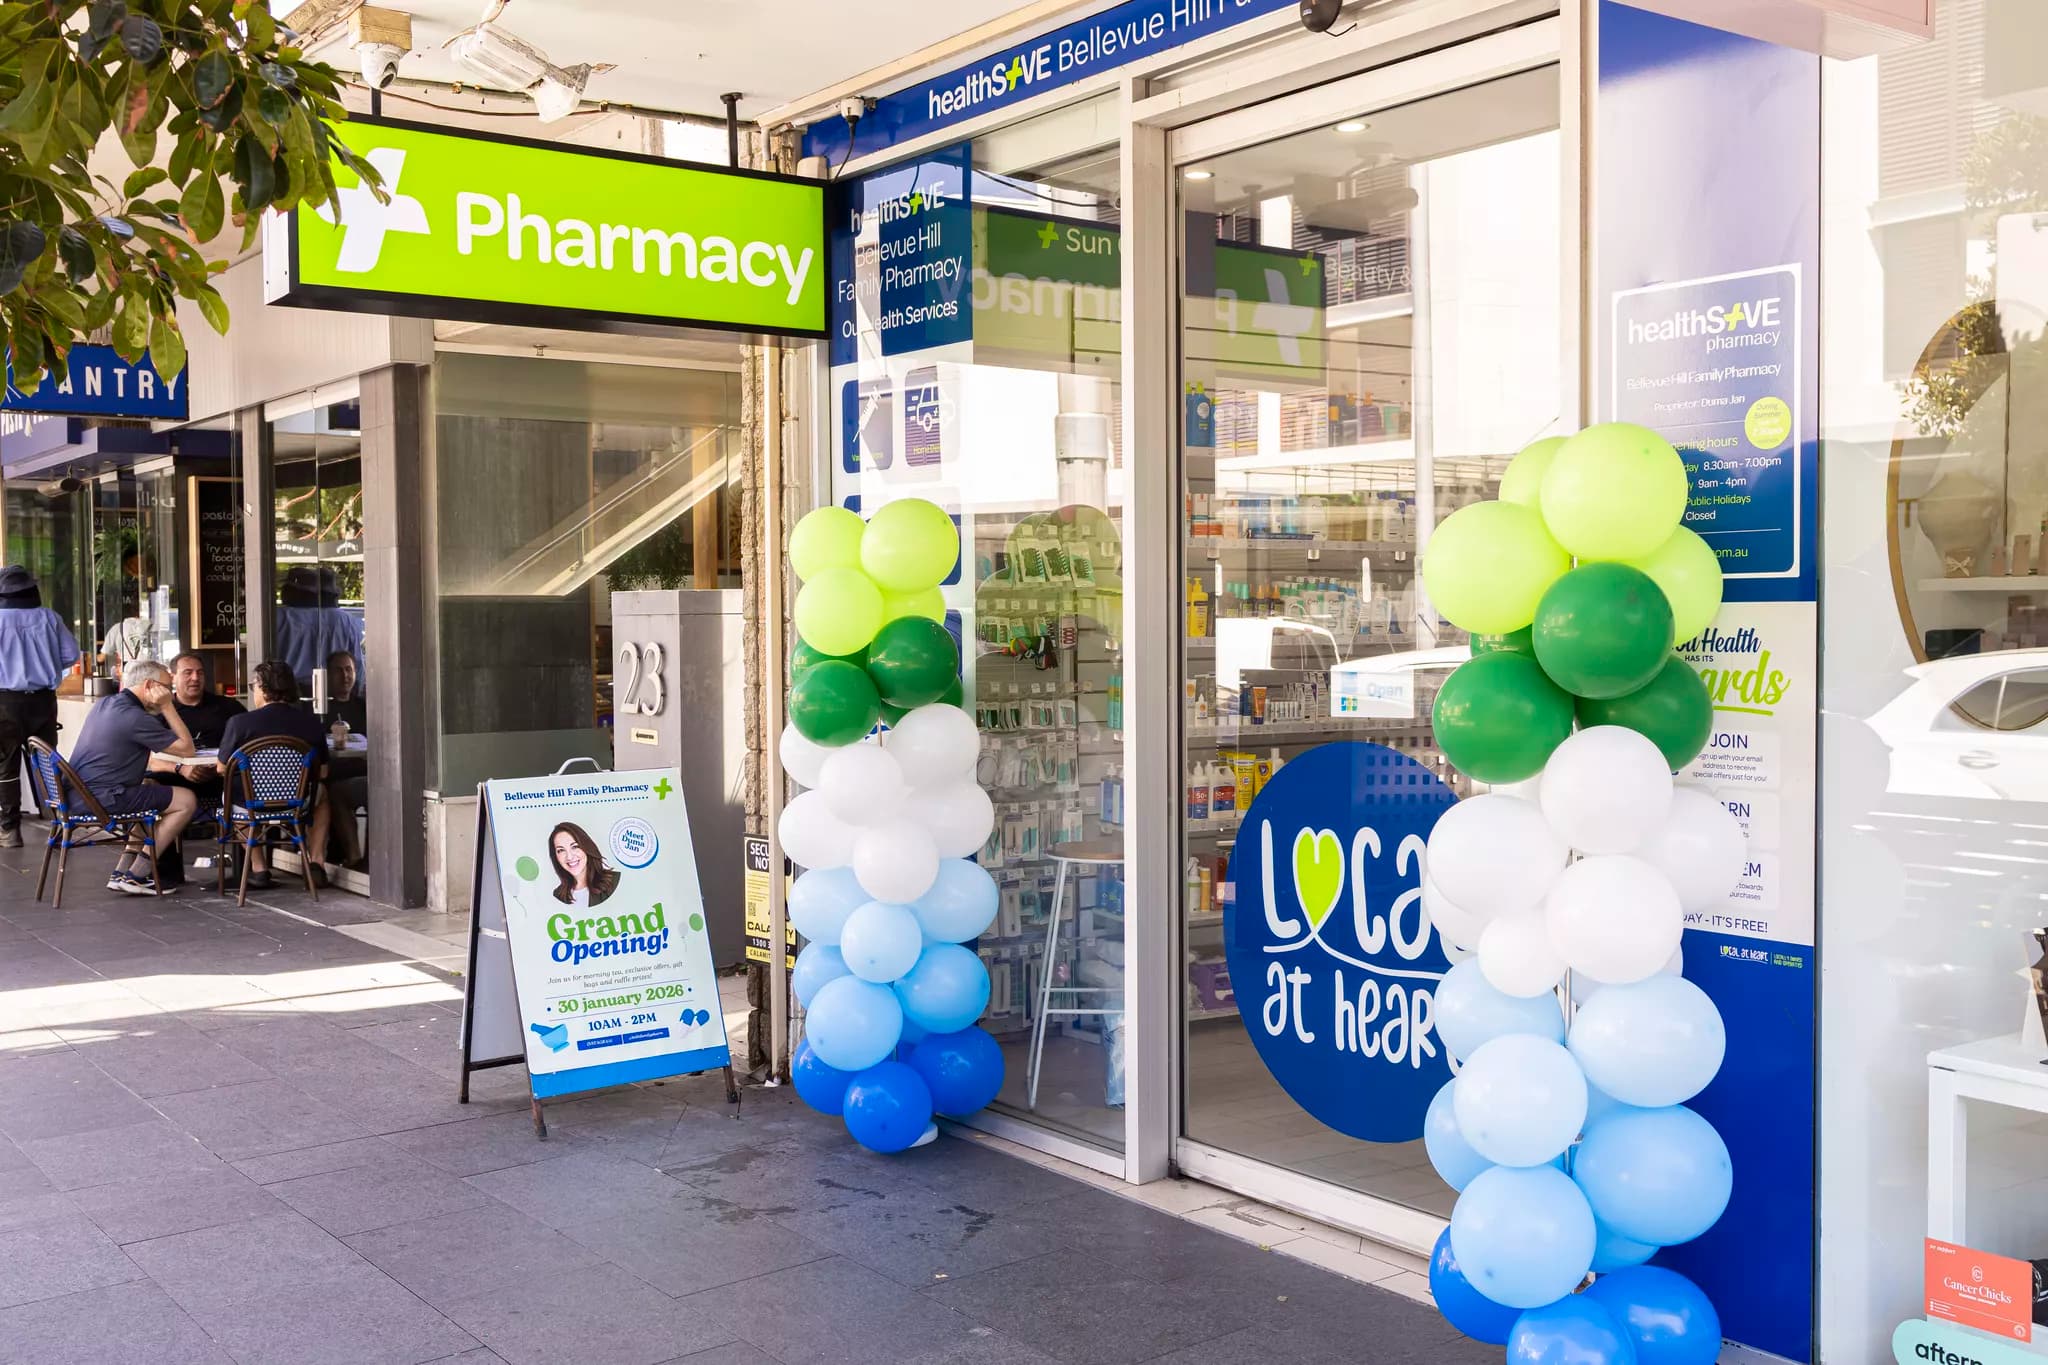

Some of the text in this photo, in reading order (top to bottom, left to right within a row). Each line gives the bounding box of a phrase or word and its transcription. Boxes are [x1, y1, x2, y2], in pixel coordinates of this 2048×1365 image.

[1059, 18, 1165, 71] Bellevue
[456, 191, 814, 306] Pharmacy
[856, 222, 941, 268] Bellevue Hill
[1066, 228, 1112, 256] Sun
[838, 256, 962, 303] Family Pharmacy
[1325, 256, 1395, 290] Beauty
[842, 300, 958, 339] Ou ealth Services
[1706, 331, 1781, 354] pharmacy
[1626, 363, 1782, 390] Bellevue Hill Family Pharmacy
[1701, 397, 1730, 407] Duma
[1729, 394, 1746, 405] Jan
[1707, 436, 1738, 448] hours
[1703, 460, 1738, 471] 8.30am
[1745, 457, 1782, 469] 7.00pm
[1698, 478, 1719, 489] 9am
[1725, 477, 1747, 488] 4pm
[1687, 494, 1752, 506] Public Holidays
[1686, 510, 1716, 520] Closed
[1700, 627, 1762, 653] Health
[620, 641, 664, 716] 23
[1710, 733, 1748, 749] JOIN
[504, 783, 649, 801] Bellevue Hill Family Pharmacy
[621, 834, 645, 848] Duma
[625, 841, 640, 852] Jan
[626, 829, 644, 841] Meet
[546, 902, 666, 942] Grand
[1712, 914, 1733, 928] IT'S
[1735, 918, 1768, 934] FREE!
[551, 927, 669, 966] Opening!
[583, 972, 611, 980] morning
[624, 965, 652, 974] exclusive
[558, 984, 684, 1014] 30 january 2026
[1263, 961, 1315, 1043] at
[588, 1017, 622, 1031] 10AM
[631, 1012, 657, 1025] 2PM
[1943, 1276, 1978, 1296] Cancer
[1978, 1285, 2012, 1305] Chicks
[1915, 1342, 1983, 1365] after
